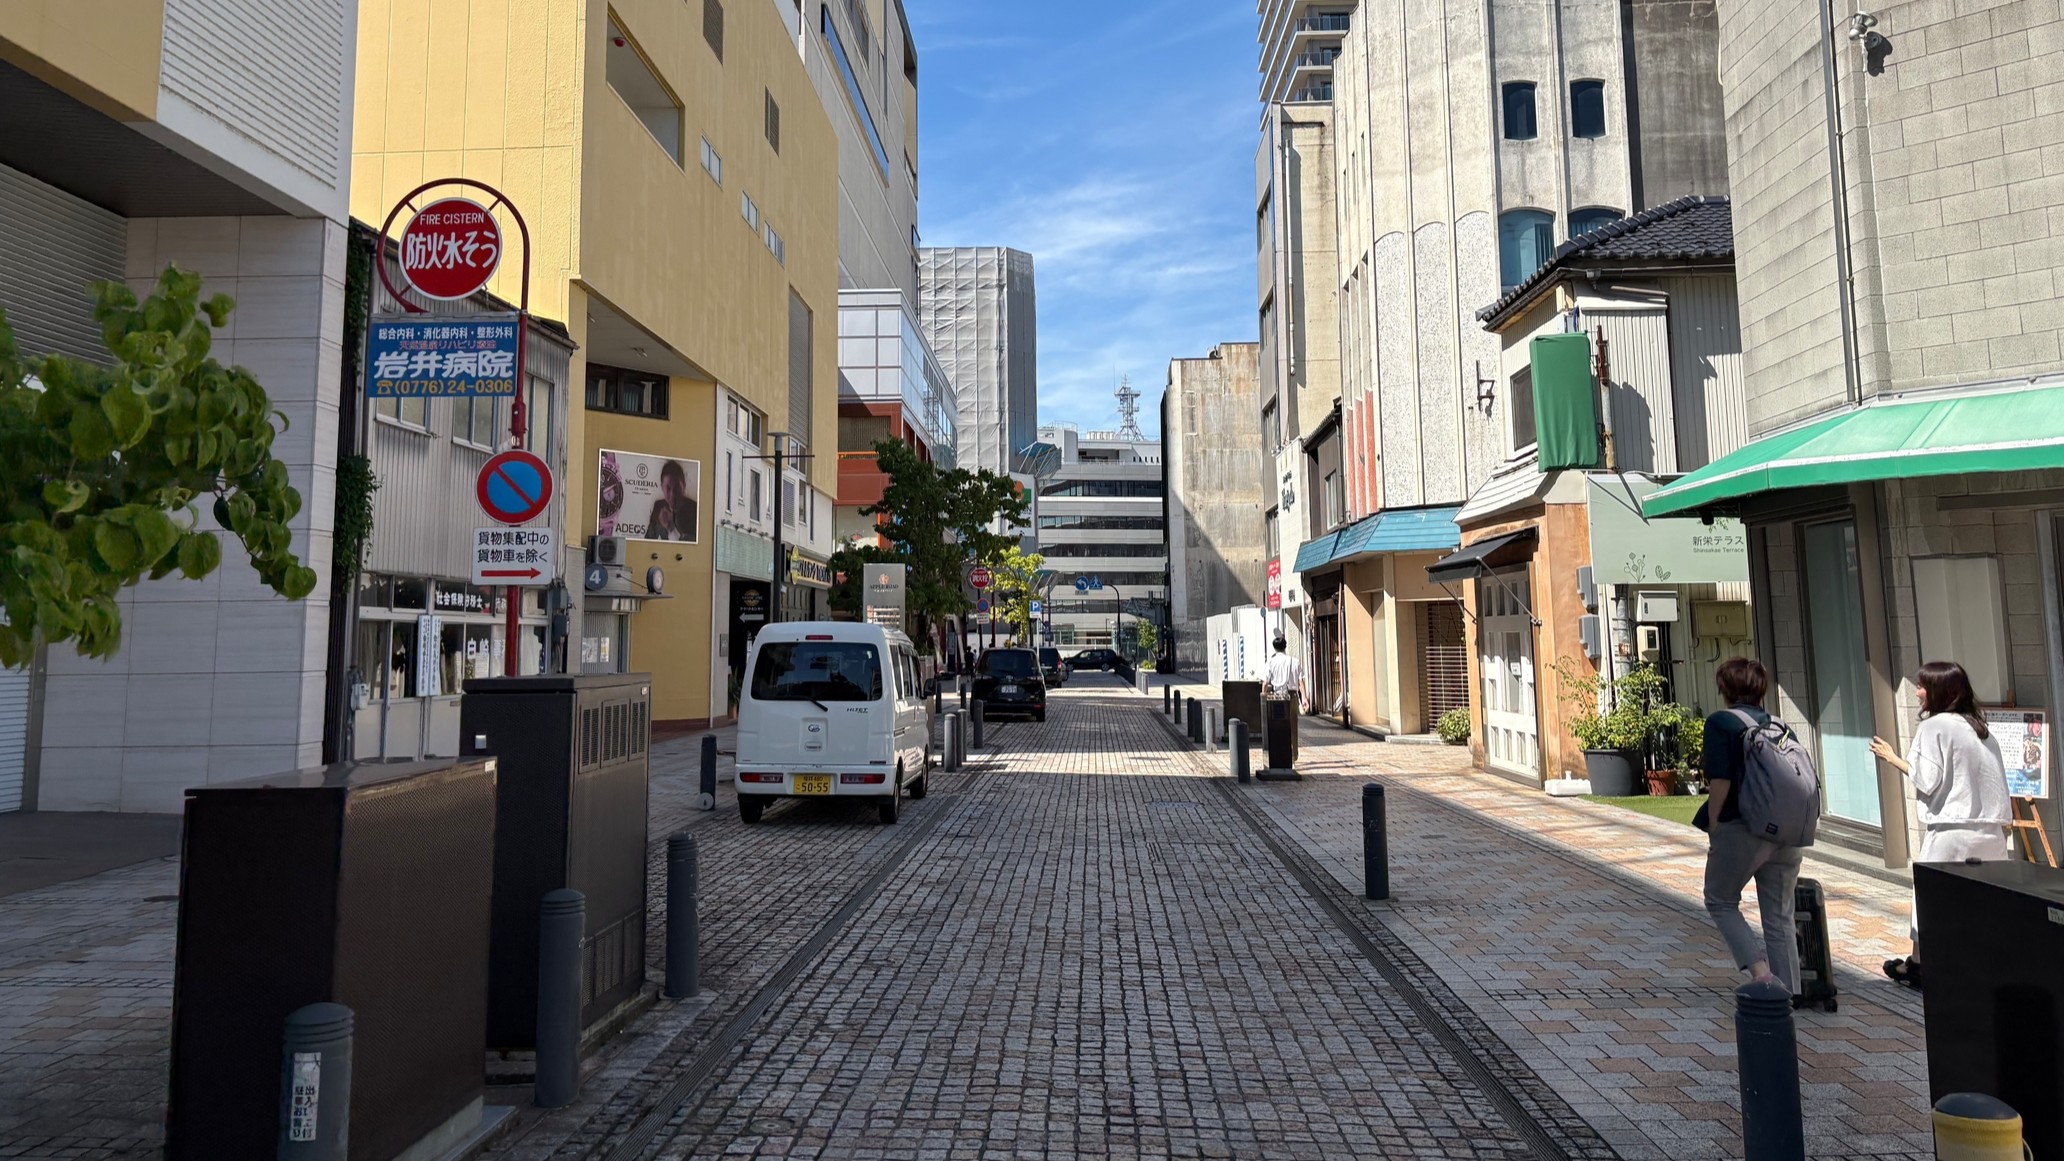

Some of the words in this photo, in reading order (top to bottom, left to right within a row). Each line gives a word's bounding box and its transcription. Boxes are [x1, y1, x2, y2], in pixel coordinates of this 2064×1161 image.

[419, 212, 441, 225] FIRE
[443, 212, 485, 225] CISTERN
[406, 230, 497, 270] 防火水そう
[374, 350, 514, 378] 岩井病院
[624, 479, 658, 488] SCUDERIA
[478, 531, 550, 546] 貨物集配中の
[1692, 536, 1744, 546] 新栄テラス
[477, 549, 548, 563] 貨物車を除く
[589, 569, 602, 585] 4
[1032, 601, 1039, 611] P
